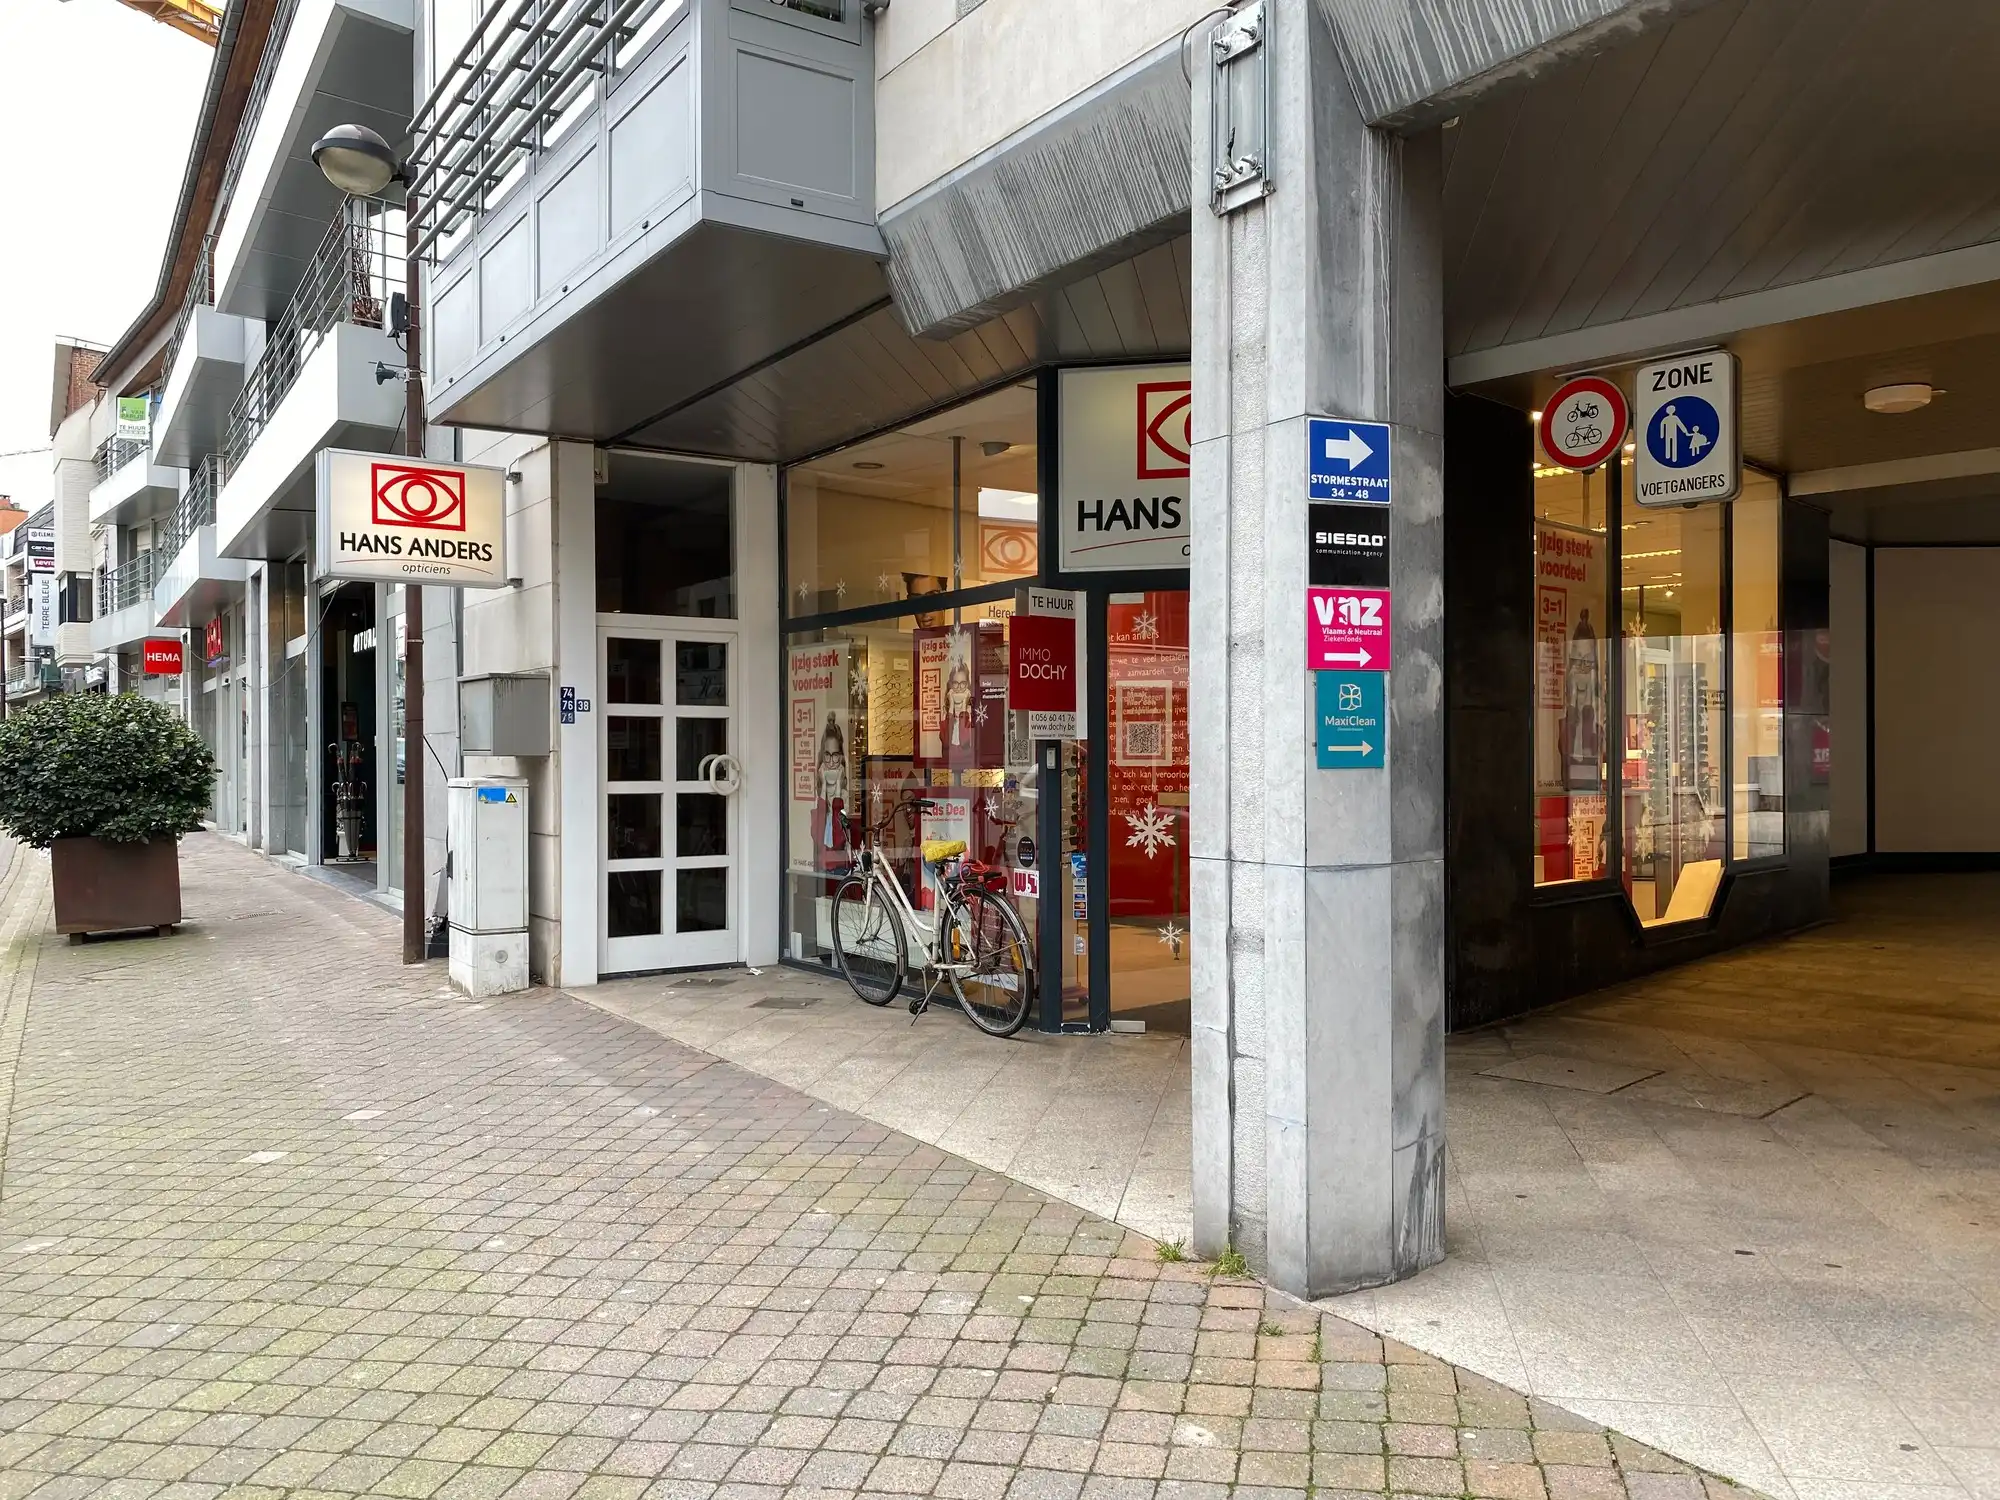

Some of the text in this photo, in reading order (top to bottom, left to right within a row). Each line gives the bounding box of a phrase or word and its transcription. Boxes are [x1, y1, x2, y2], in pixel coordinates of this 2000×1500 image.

[1652, 362, 1713, 392] ZONE
[1311, 474, 1389, 488] STORMESTRAAT
[1641, 474, 1725, 497] VOETGANGERS
[1331, 488, 1345, 497] 34
[1355, 490, 1369, 499] 48
[1078, 496, 1182, 532] HANS
[340, 532, 493, 562] HANS ANDERS
[1566, 540, 1593, 559] sterk
[402, 563, 451, 575] opticiens
[1539, 559, 1586, 582] voordeel
[1032, 596, 1074, 611] TE HUUR
[1543, 597, 1562, 616] 3=1
[1116, 632, 1130, 642] kan
[1322, 627, 1346, 635] Vlaams
[1354, 628, 1382, 636] Neutraal
[1323, 635, 1362, 643] Ziekenfonds
[146, 653, 181, 662] HEMA
[813, 650, 839, 669] sterk
[1019, 647, 1051, 661] IMMO
[1143, 655, 1157, 663] veel
[1160, 653, 1186, 662] betalen
[1019, 663, 1067, 680] DOCHY
[792, 671, 833, 692] voordeel
[924, 673, 938, 684] 3=1
[562, 688, 573, 698] 74
[562, 700, 574, 710] 76
[577, 701, 589, 710] 38
[561, 713, 573, 723] 78
[797, 708, 812, 723] 3=1
[1035, 713, 1047, 721] 056
[1031, 722, 1075, 732] www.dochy.be
[1325, 716, 1376, 727] MaxiClean
[1164, 784, 1174, 792] op
